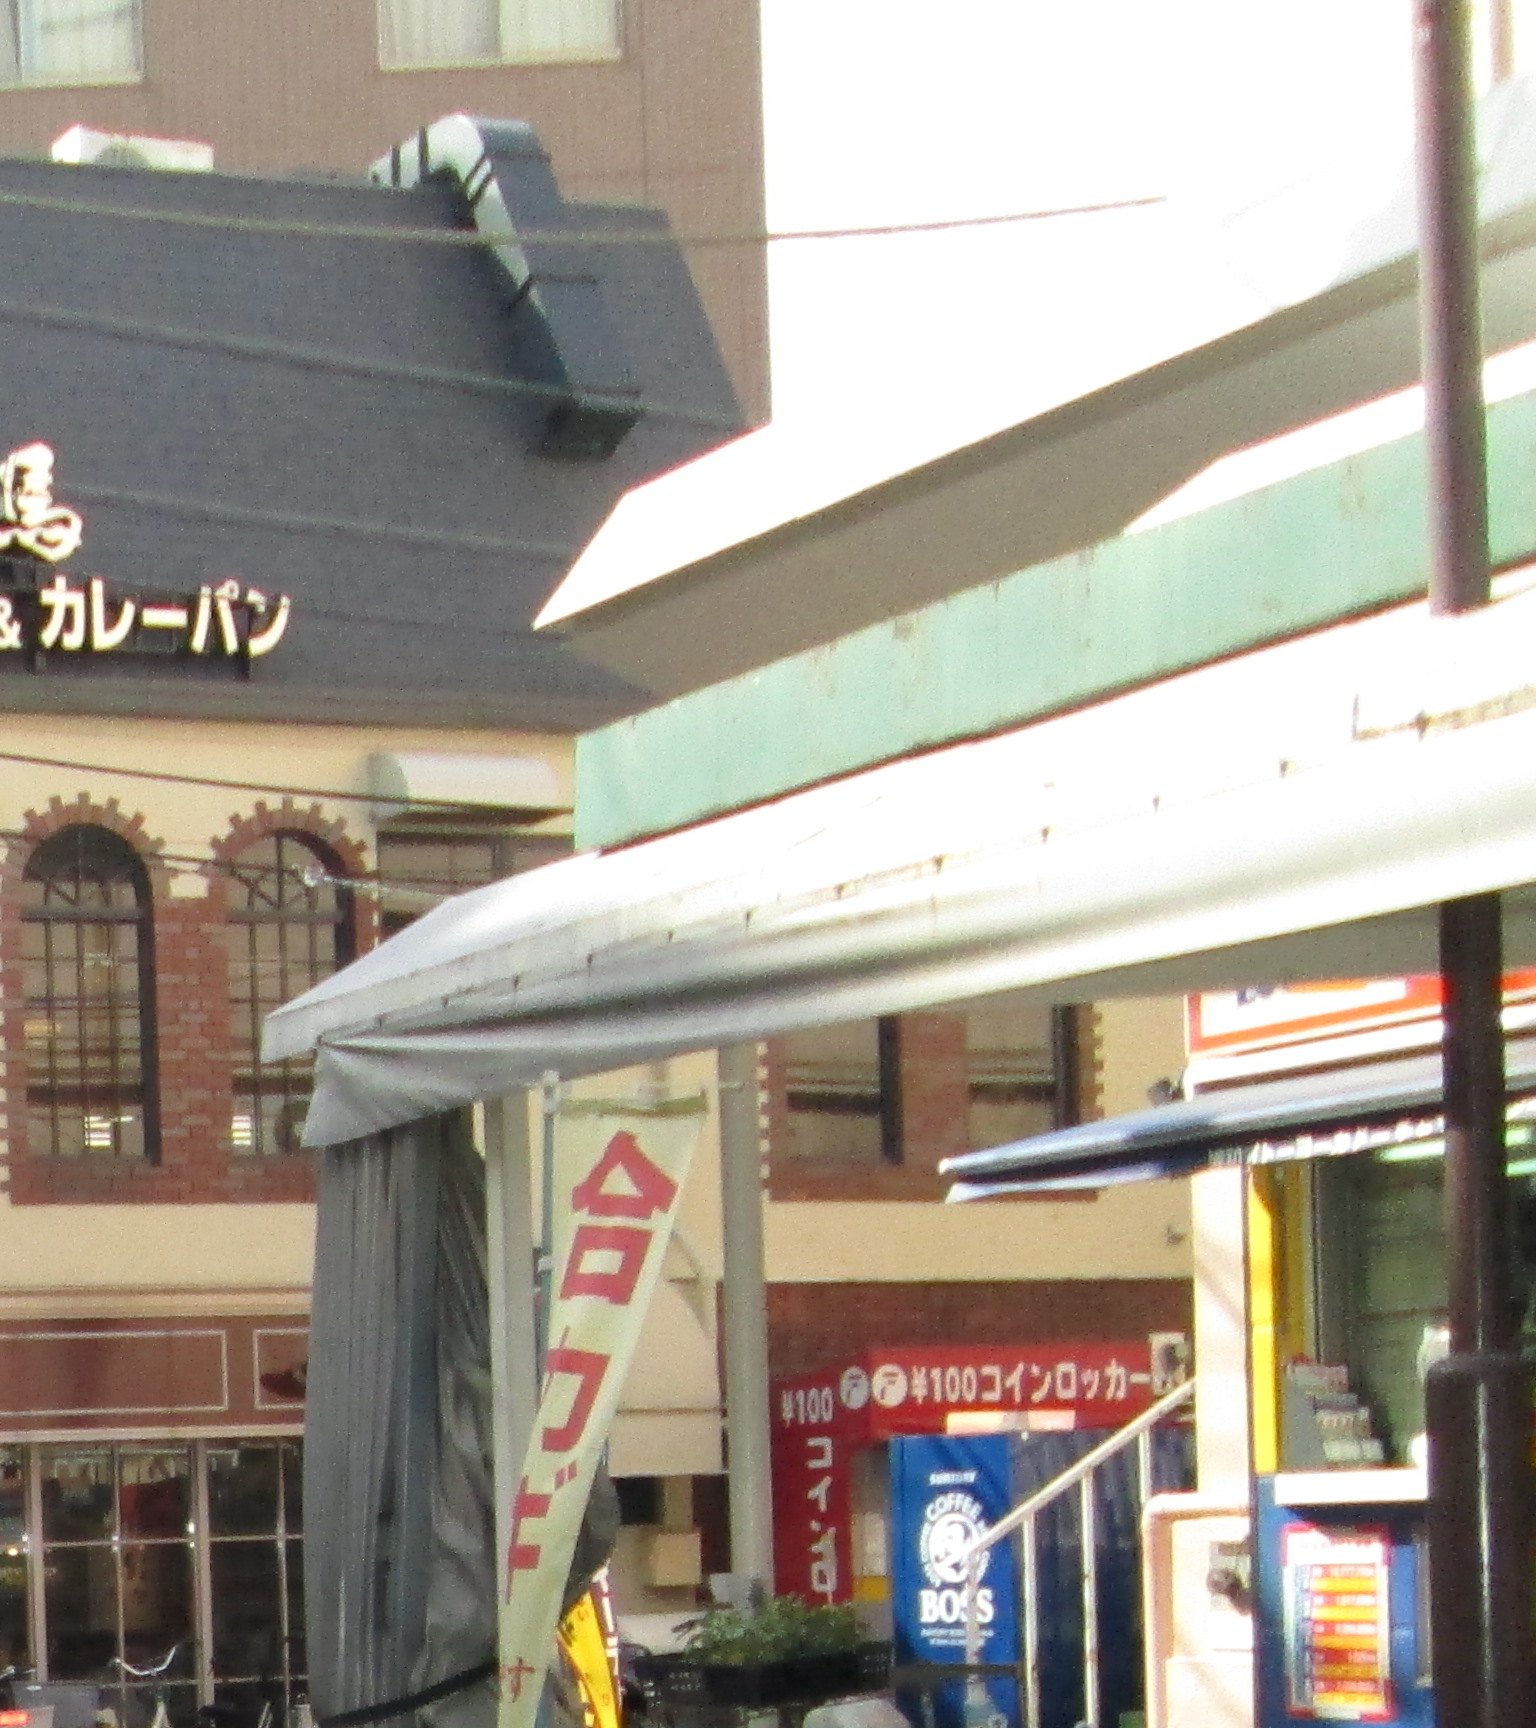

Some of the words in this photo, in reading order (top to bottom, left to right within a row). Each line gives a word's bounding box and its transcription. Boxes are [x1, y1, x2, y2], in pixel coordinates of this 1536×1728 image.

[38, 576, 291, 657] カレーパン
